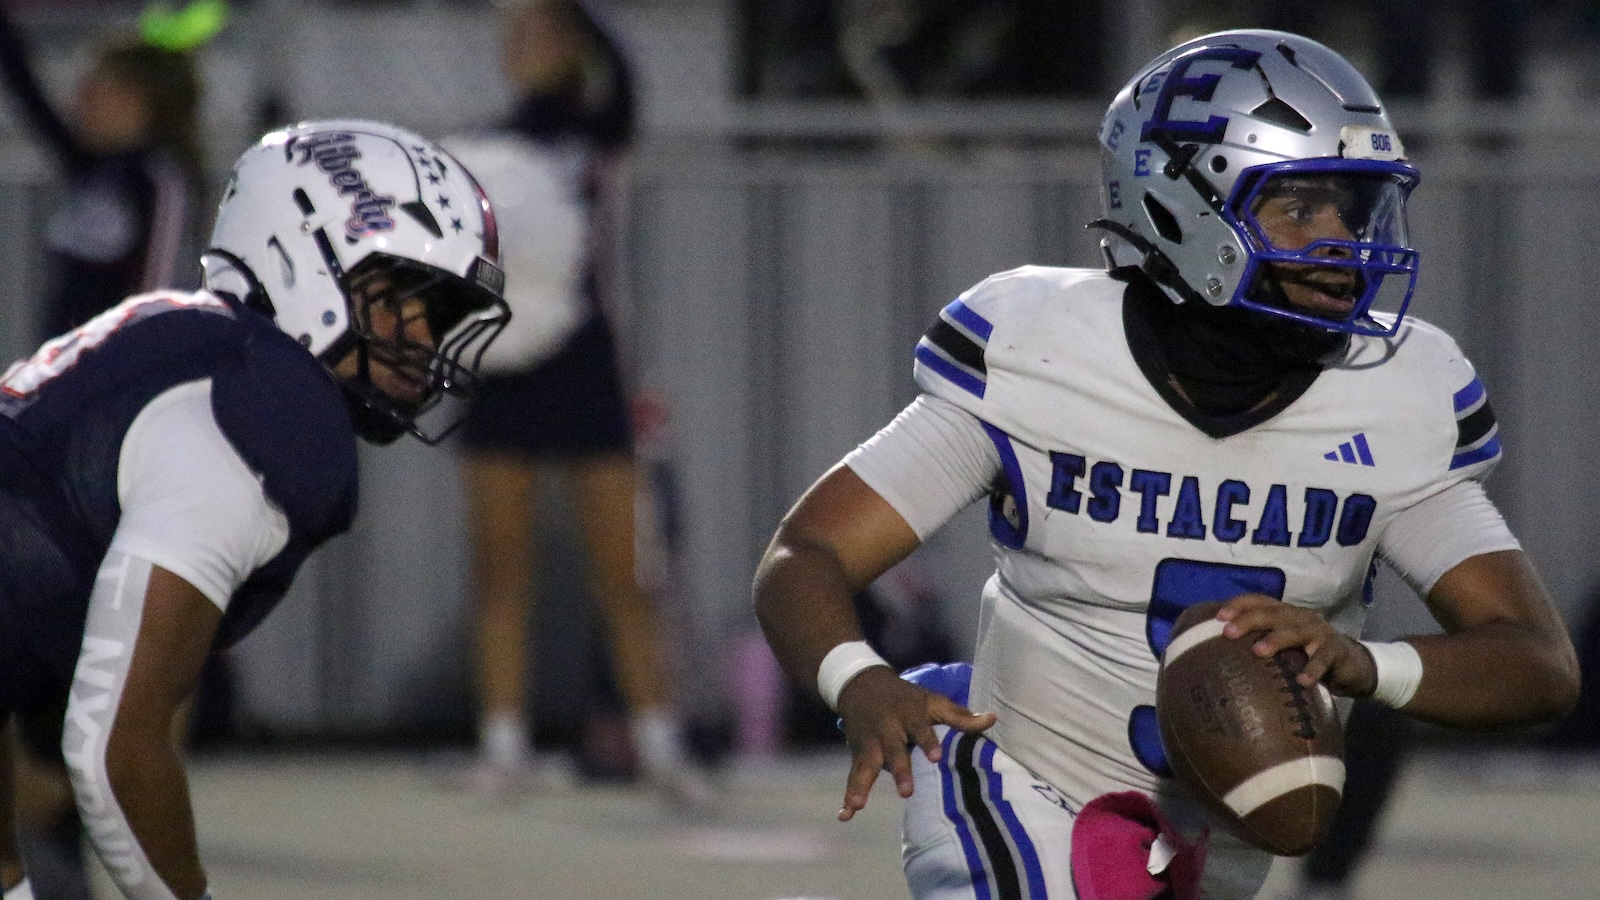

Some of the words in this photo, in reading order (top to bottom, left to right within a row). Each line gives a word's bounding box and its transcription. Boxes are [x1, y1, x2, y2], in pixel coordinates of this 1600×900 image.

[1140, 48, 1262, 145] E
[1371, 133, 1391, 152] 806
[285, 131, 397, 238] Liberty
[1134, 150, 1151, 177] E
[1046, 450, 1377, 548] ESTACADO
